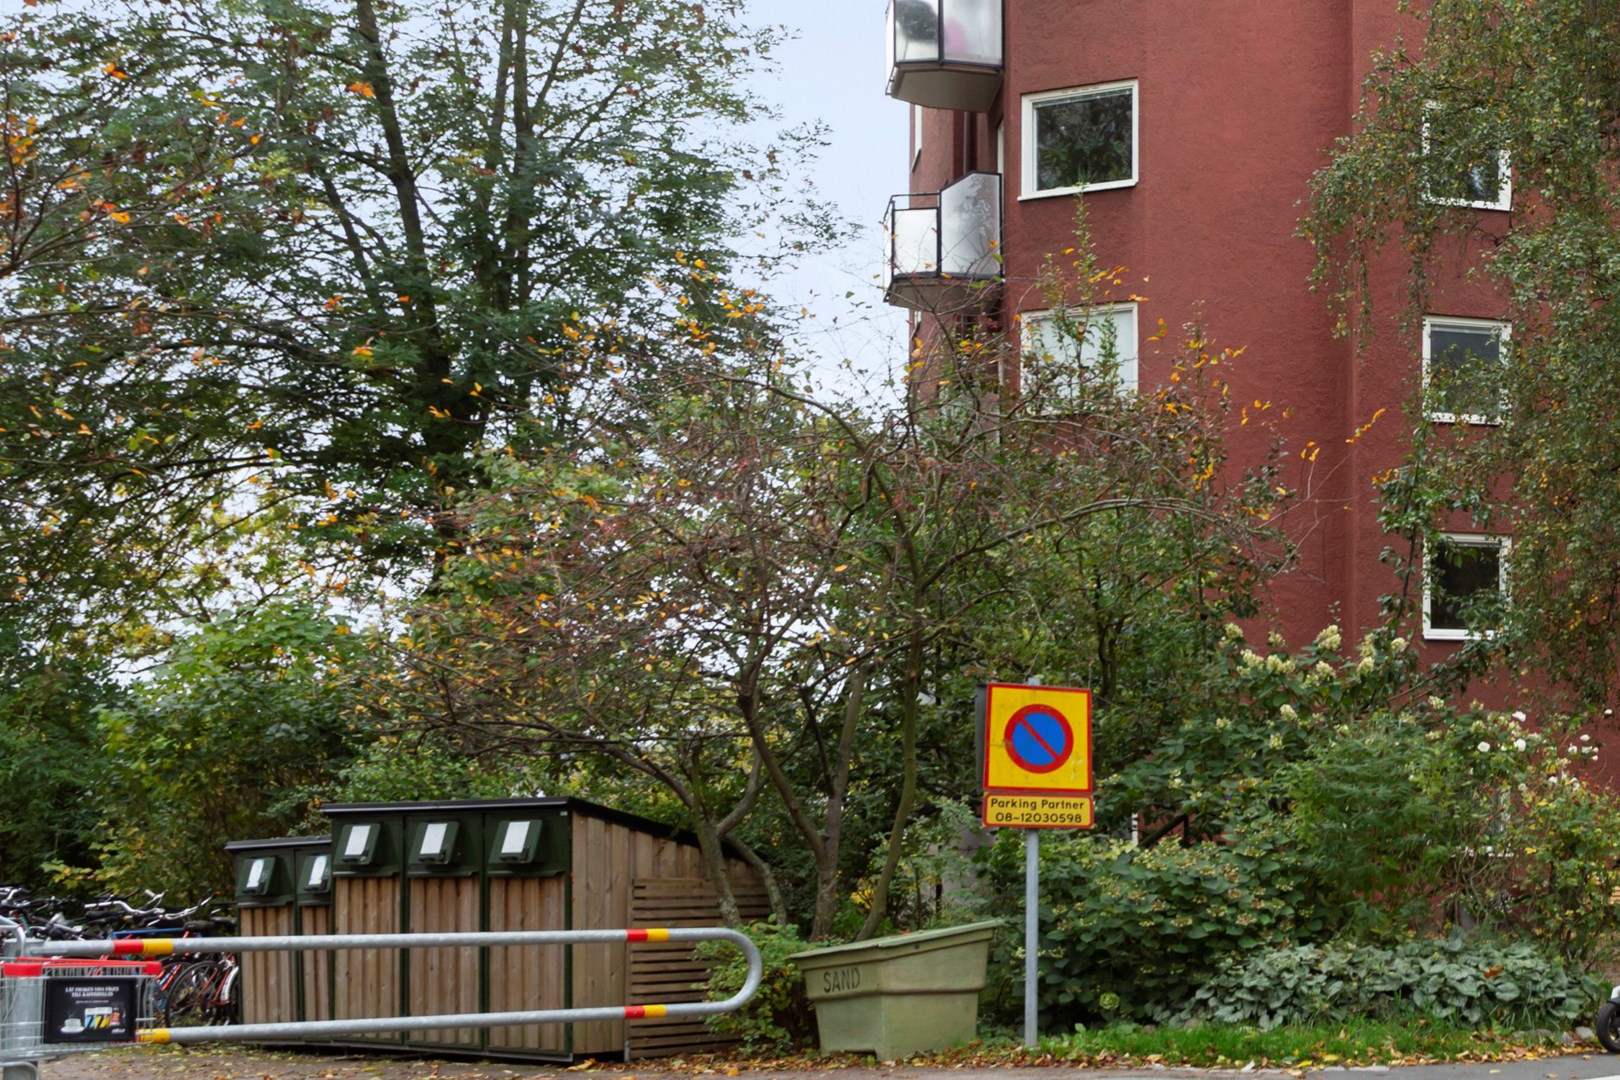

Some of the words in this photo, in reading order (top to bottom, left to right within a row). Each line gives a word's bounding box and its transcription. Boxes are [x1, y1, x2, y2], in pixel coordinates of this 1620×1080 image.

[990, 798, 1037, 811] Parking
[1041, 799, 1085, 810] Partner
[995, 812, 1082, 823] 08-12030598
[823, 967, 861, 994] SAND
